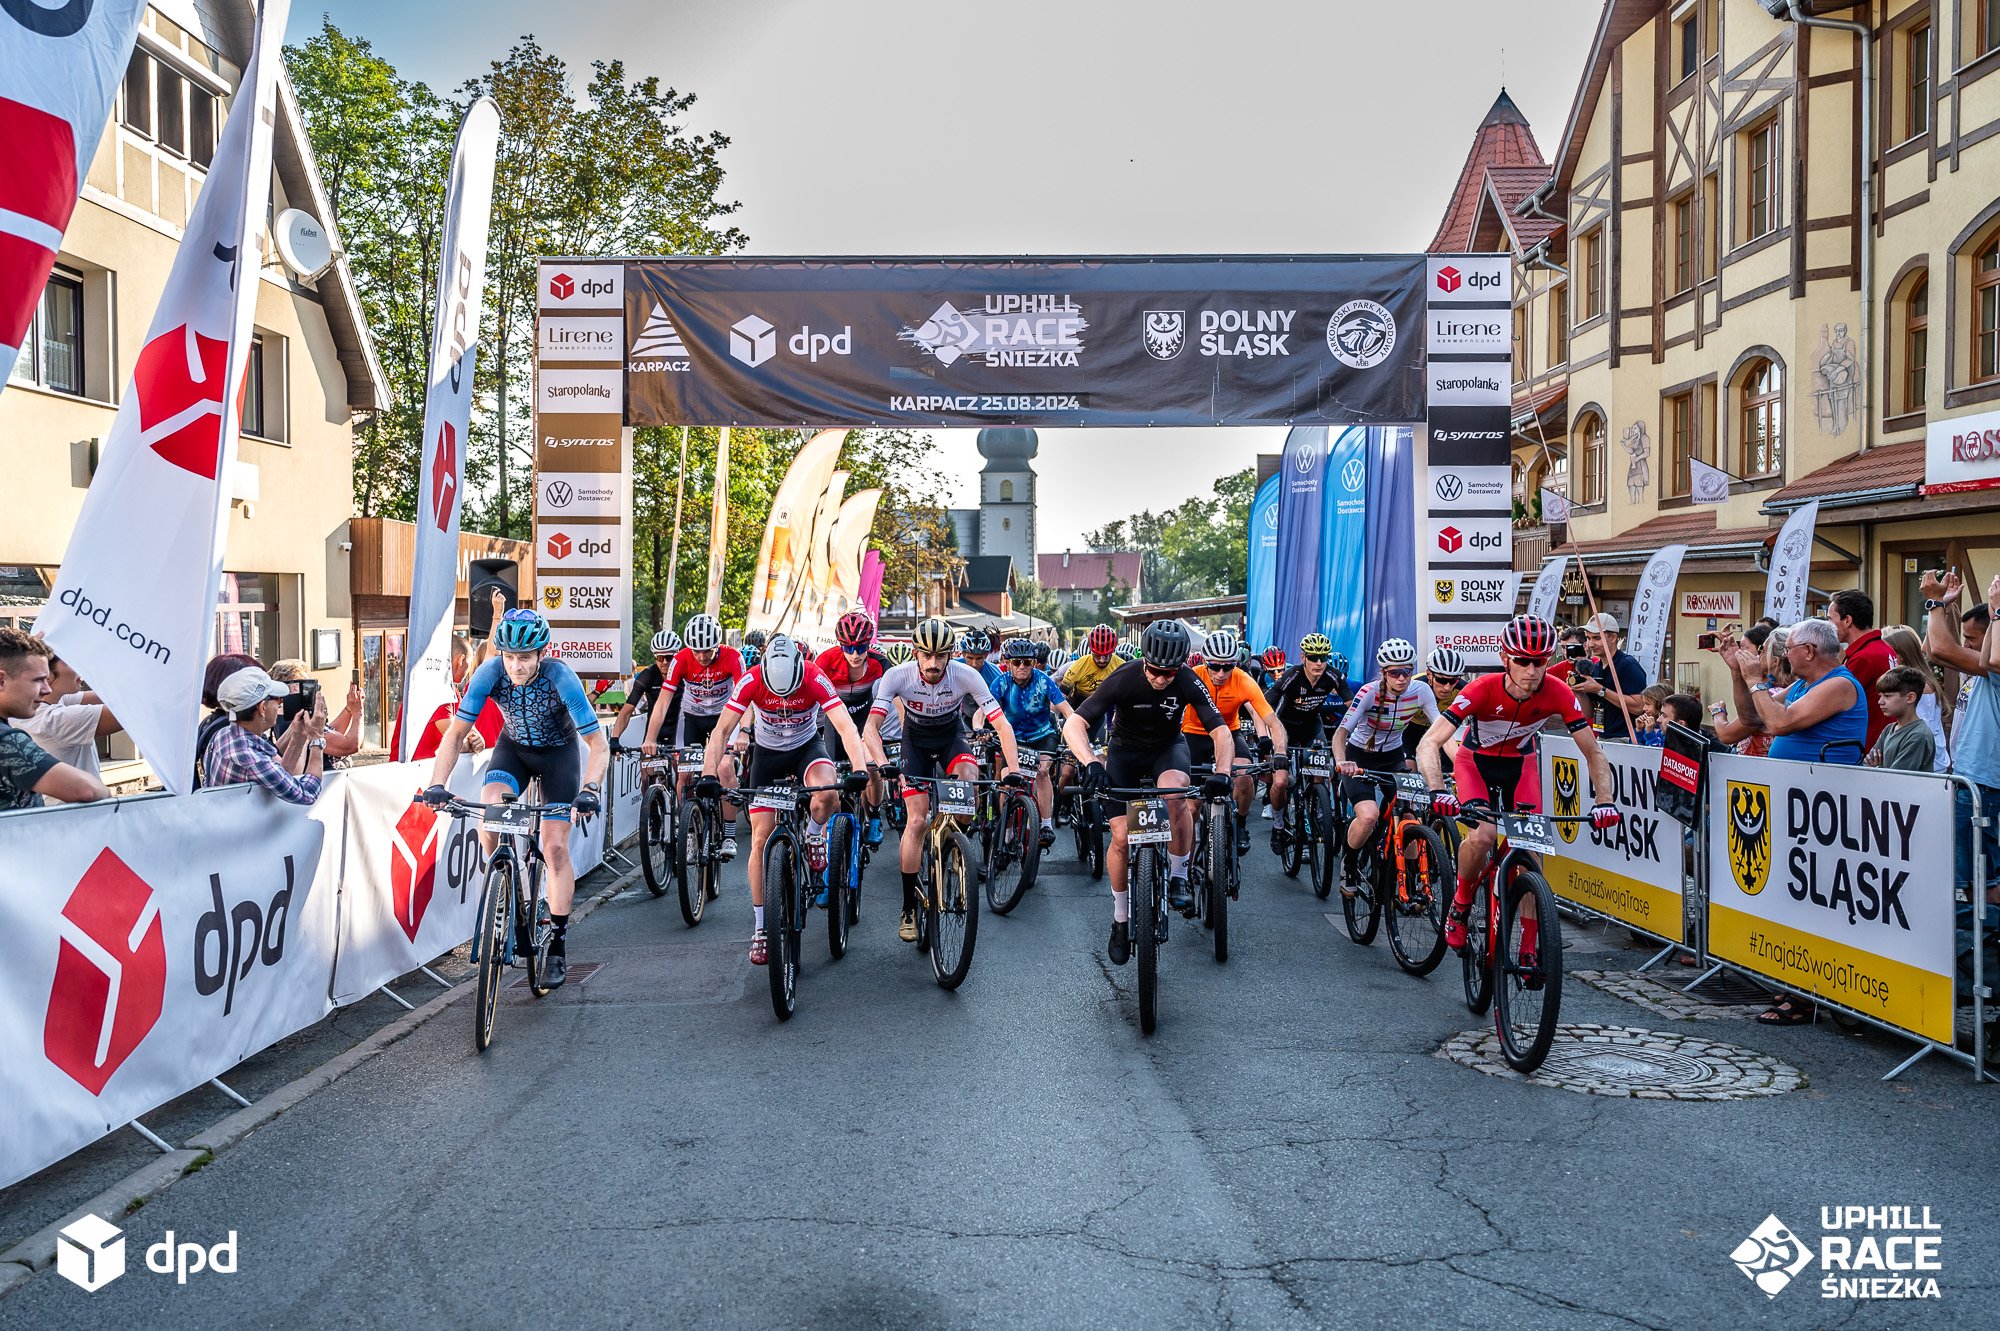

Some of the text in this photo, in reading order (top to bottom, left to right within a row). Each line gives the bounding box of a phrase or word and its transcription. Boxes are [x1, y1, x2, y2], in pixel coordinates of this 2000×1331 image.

[300, 228, 317, 236] fuba
[581, 278, 614, 298] dpd
[1467, 271, 1501, 290] dpd
[985, 294, 1079, 314] UPHILL
[1200, 310, 1297, 332] DOLNY
[1436, 320, 1501, 336] Lirene
[549, 327, 613, 344] Lirene
[985, 318, 1080, 345] RACE
[1329, 302, 1394, 358] KARKONOSKI PARK NARODOWY
[788, 326, 851, 362] dpd
[1200, 329, 1289, 359] ŚLĄSK
[985, 347, 1079, 368] ŚNIEŻKA
[628, 361, 691, 372] KARPACZ
[548, 383, 611, 399] Staropolanka
[1436, 376, 1500, 391] Staropolanka
[890, 396, 1079, 411] KARPACZ 25.08.2024
[558, 437, 616, 447] syncros
[1448, 430, 1505, 440] syncros
[1291, 479, 1318, 487] Samochody
[1467, 481, 1504, 489] Samochody
[578, 488, 614, 497] Samochody
[579, 538, 611, 557] dpd
[1469, 532, 1502, 551] dpd
[569, 586, 614, 597] DOLNY
[1461, 580, 1505, 591] DOLNY
[569, 596, 611, 610] ŚLĄSK
[1461, 589, 1503, 603] ŚLĄSK
[1686, 594, 1734, 611] ROSSMANN
[60, 586, 172, 666] dpd.com
[561, 642, 612, 651] GRABEK
[1651, 602, 1665, 676] RESTAURACJA
[561, 651, 613, 659] PROMOTION
[1193, 679, 1220, 714] SZCZECIN
[684, 753, 704, 761] 145
[1018, 753, 1036, 766] 295
[1308, 754, 1326, 766] 168
[1663, 756, 1698, 780] DATASPORT
[1400, 777, 1424, 789] 286
[948, 787, 965, 799] 38
[502, 809, 513, 820] 4
[1138, 810, 1158, 826] 84
[1513, 821, 1545, 838] 143
[1787, 787, 1920, 861] DOLNY
[1787, 836, 1911, 931] ŚLĄSK
[1568, 870, 1650, 920] #ZnajdźSwojąTrasę
[194, 855, 295, 1017] dpd
[1748, 931, 1890, 1007] #ZnajdźSwojąTrasę
